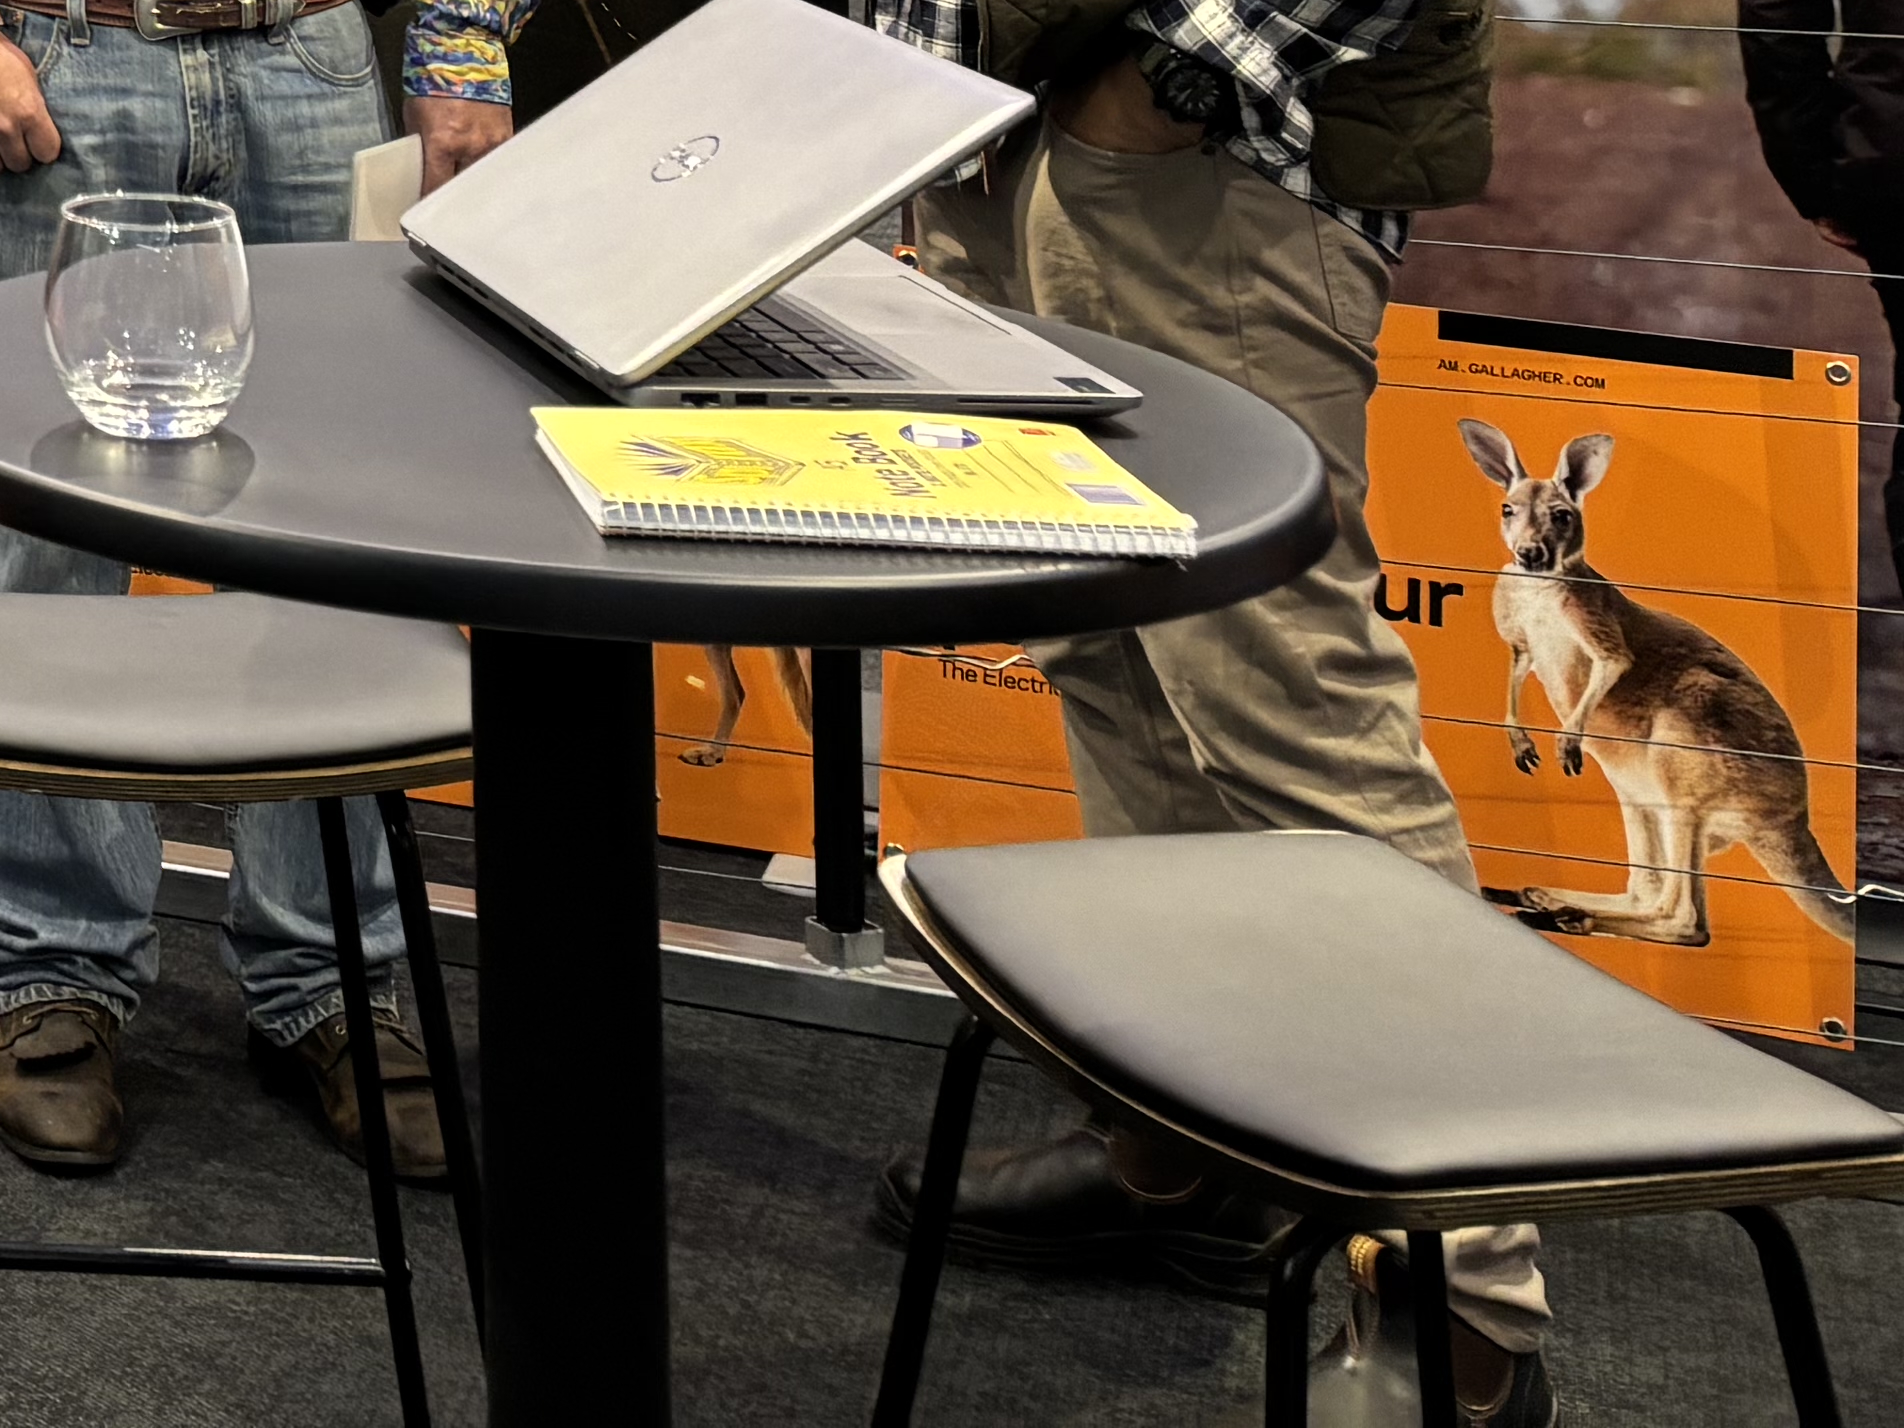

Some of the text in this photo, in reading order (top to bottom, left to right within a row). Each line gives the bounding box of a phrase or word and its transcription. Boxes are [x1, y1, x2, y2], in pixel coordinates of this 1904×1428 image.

[1436, 358, 1606, 390] AM.GALLAGHER.COM
[1373, 571, 1464, 628] ur
[938, 658, 978, 683] The
